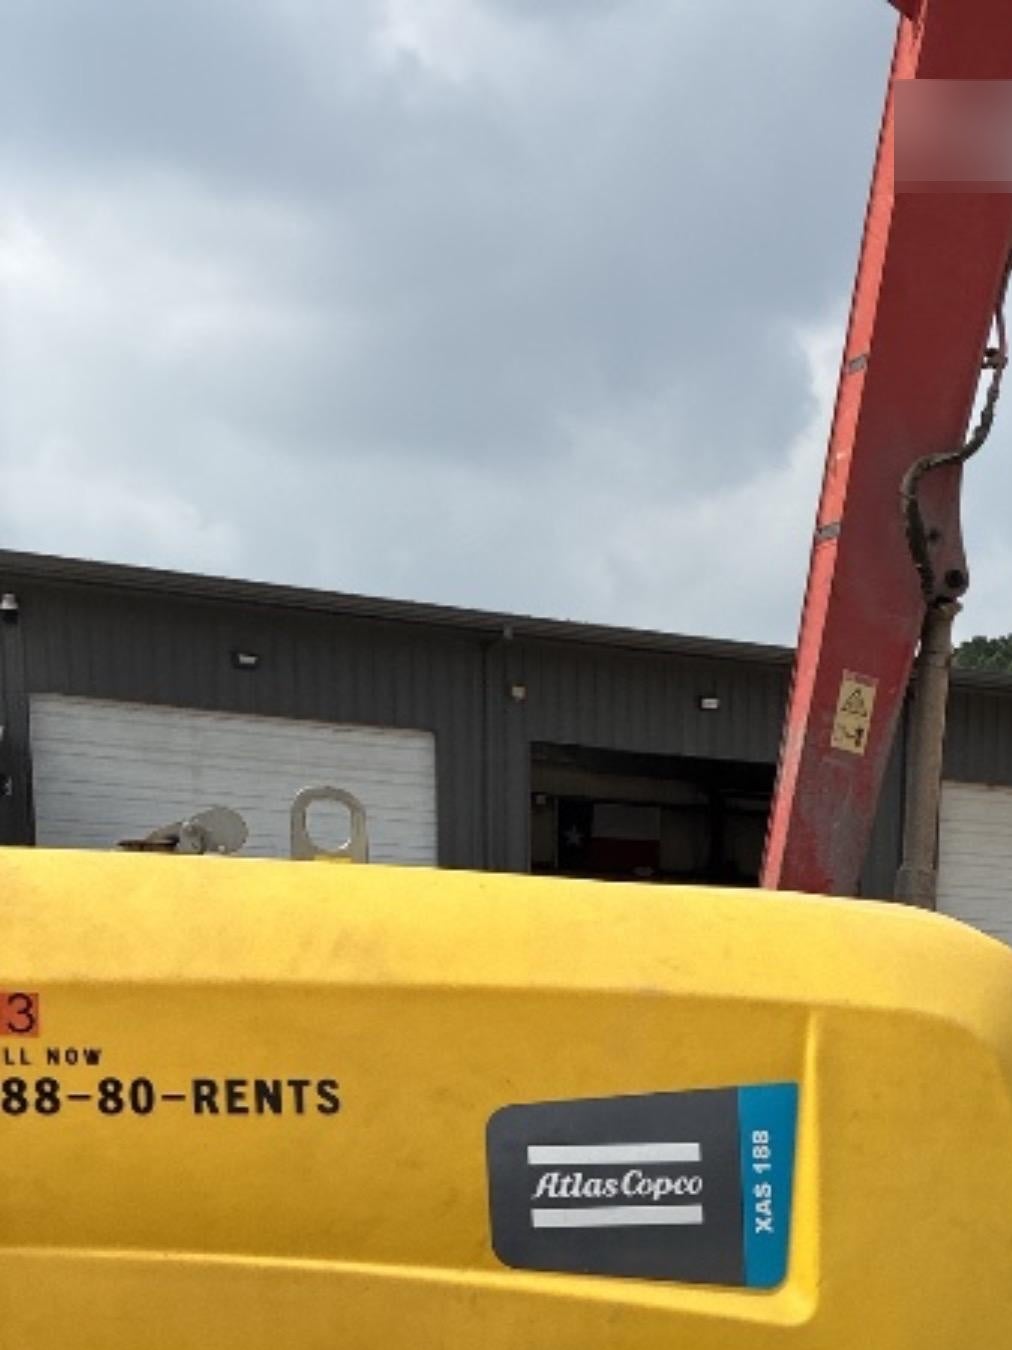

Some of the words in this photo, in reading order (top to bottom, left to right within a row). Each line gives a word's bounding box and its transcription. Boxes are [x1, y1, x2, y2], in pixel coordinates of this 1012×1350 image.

[7, 992, 35, 1033] 3
[46, 1046, 102, 1066] NOW
[1, 1077, 342, 1115] 88-80-RENTS
[532, 1171, 618, 1200] Atlas
[620, 1168, 703, 1201] Copco
[754, 1182, 775, 1235] XAS
